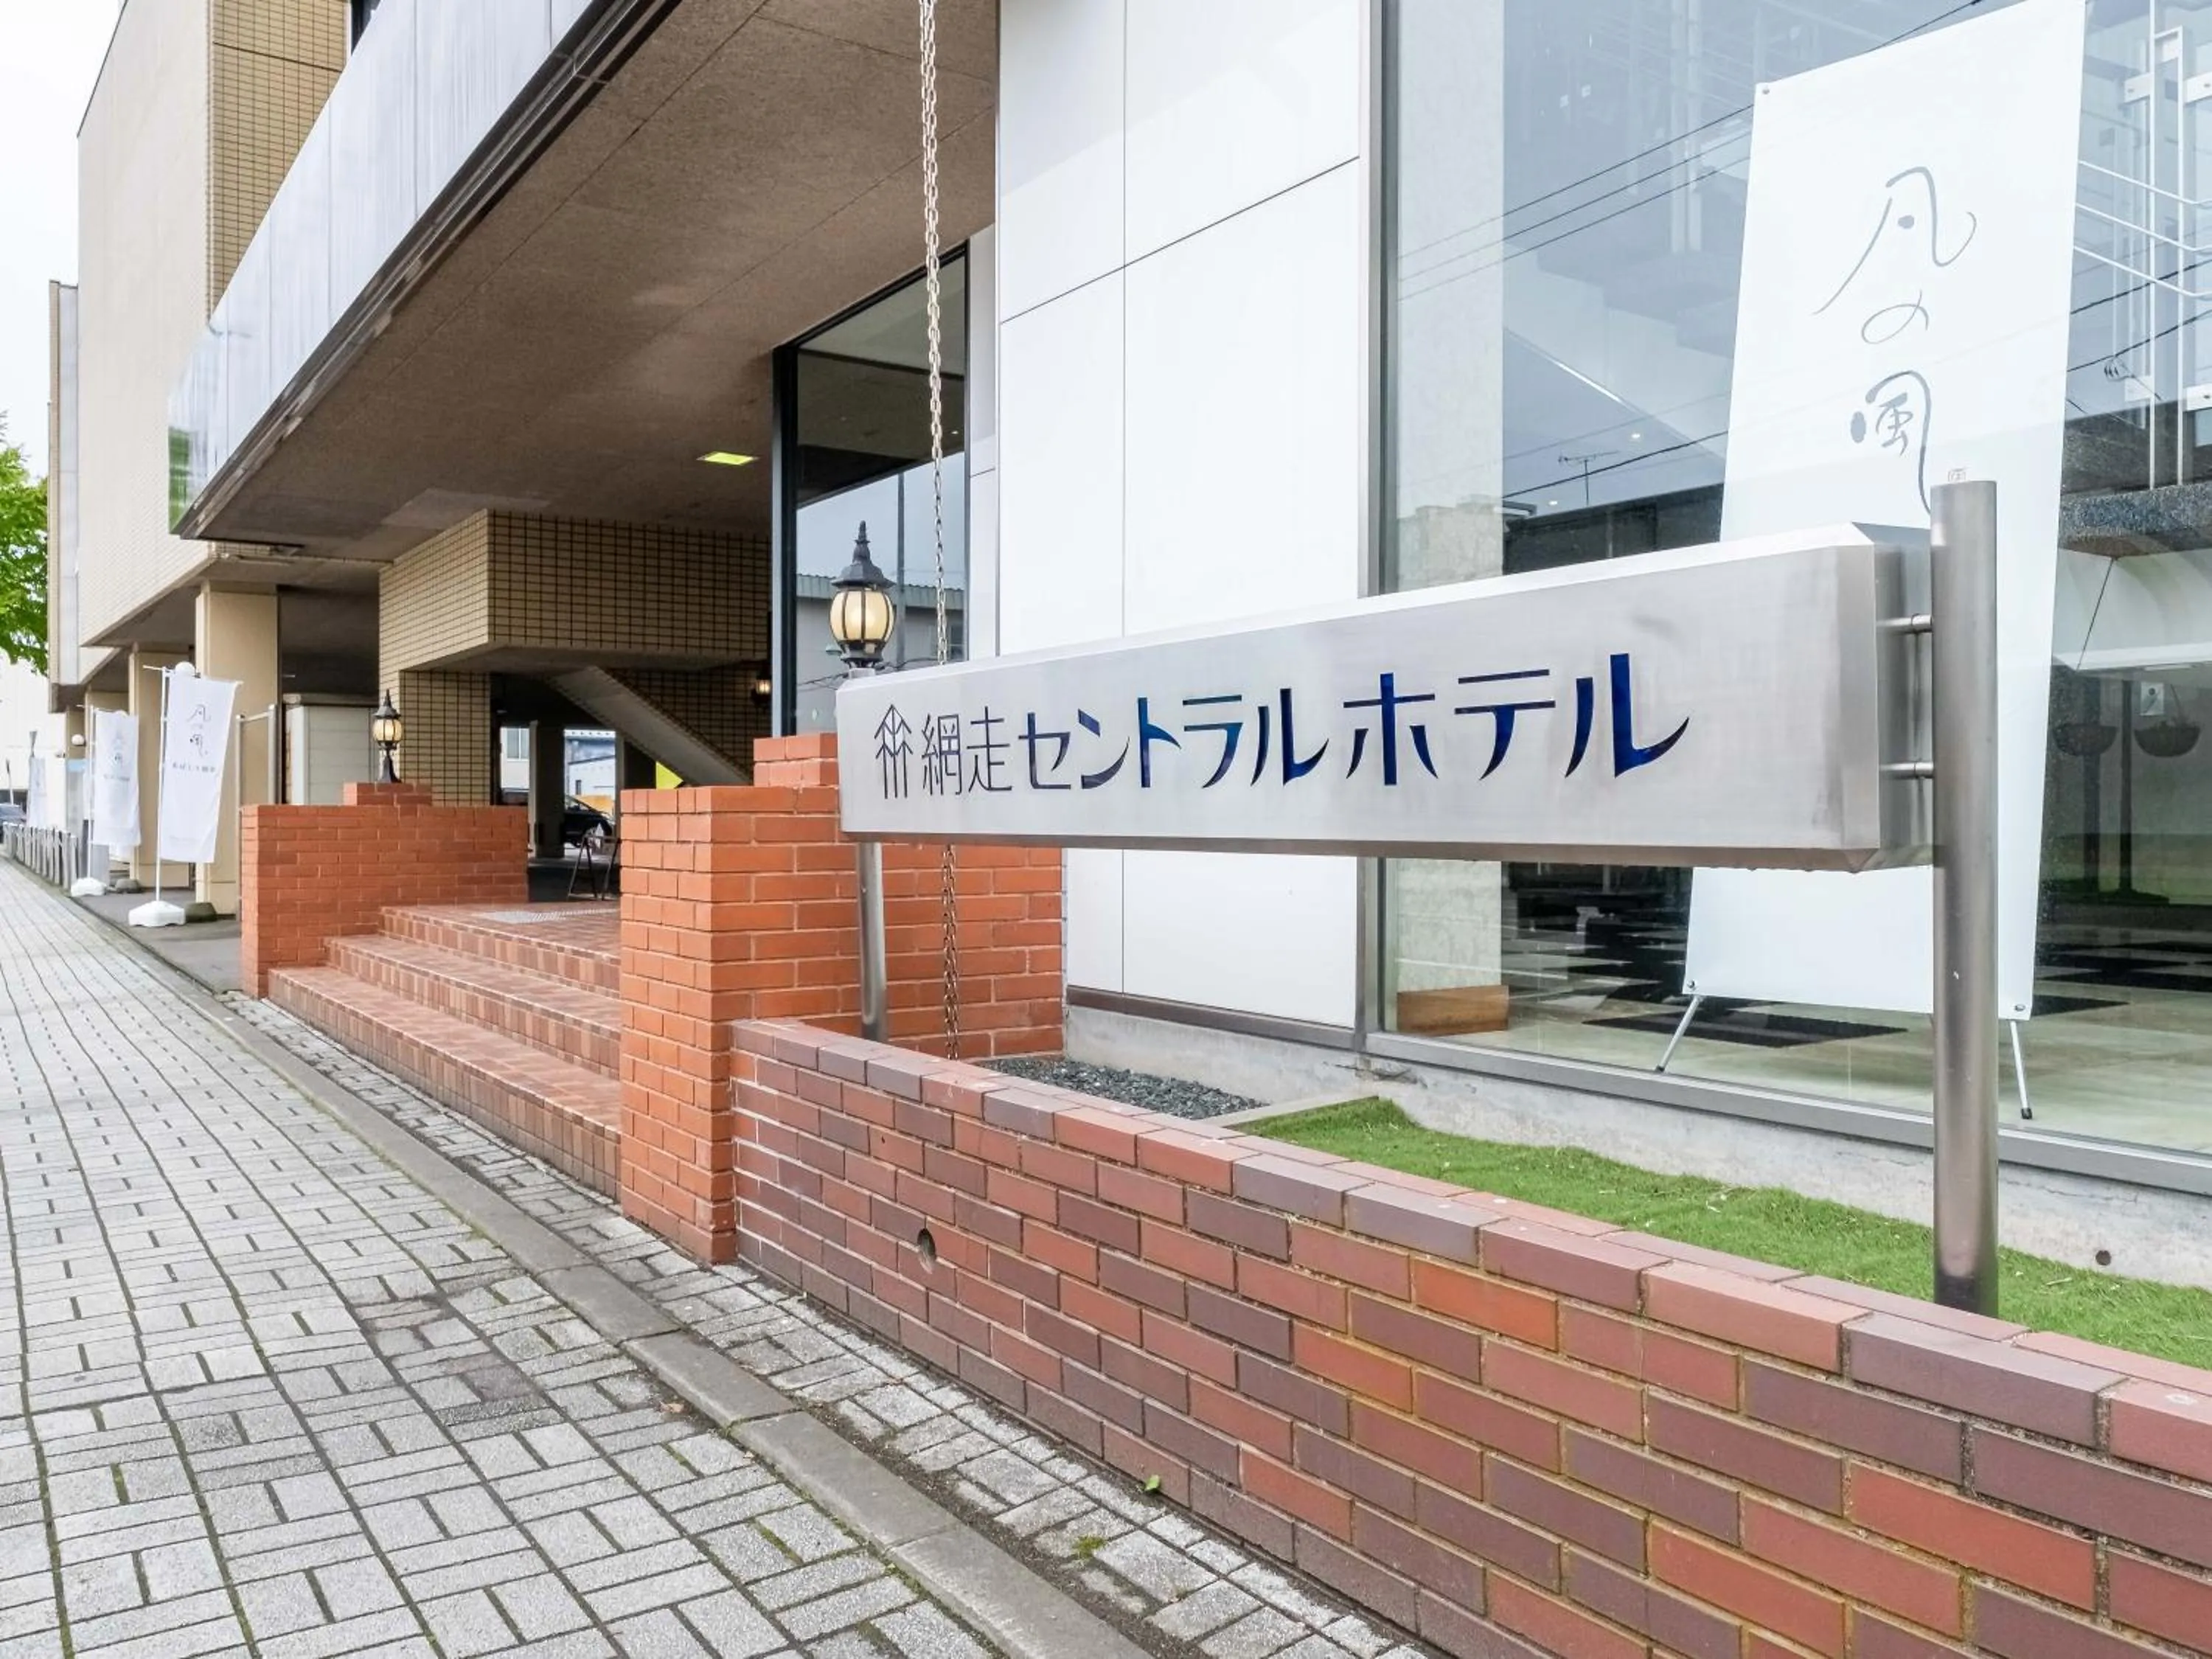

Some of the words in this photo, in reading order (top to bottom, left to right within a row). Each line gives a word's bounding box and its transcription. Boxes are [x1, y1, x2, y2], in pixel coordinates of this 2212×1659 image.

[921, 653, 1690, 798] 網走セントラルホテル
